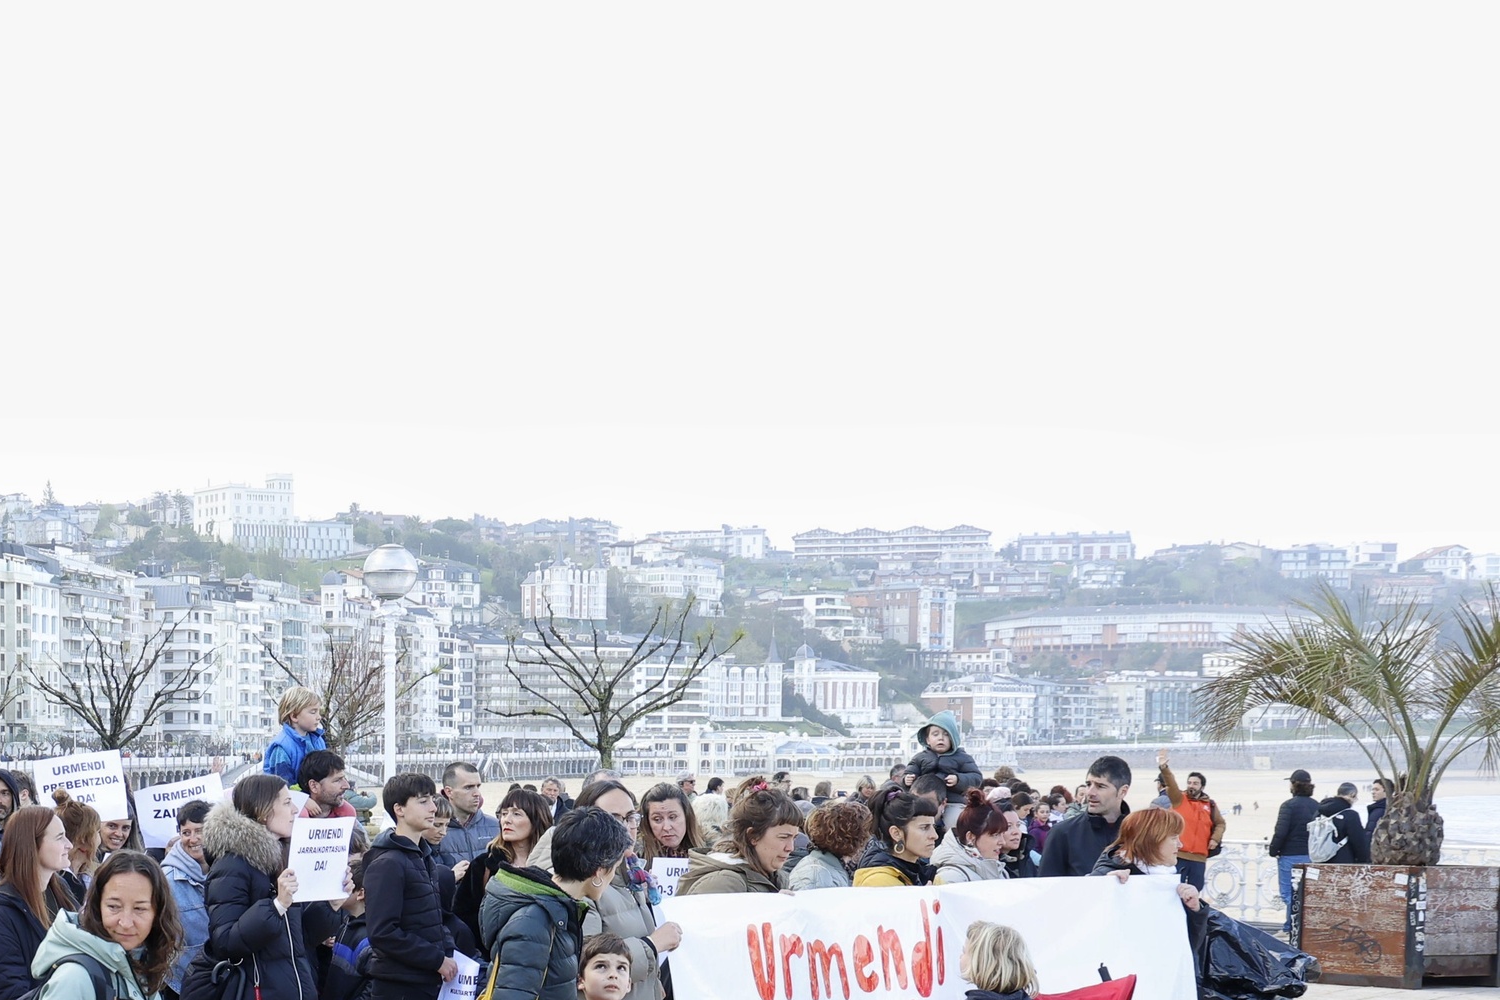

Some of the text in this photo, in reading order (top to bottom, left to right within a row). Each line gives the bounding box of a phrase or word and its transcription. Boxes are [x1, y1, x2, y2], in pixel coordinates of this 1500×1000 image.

[52, 760, 106, 776] URMENDI
[43, 774, 120, 794] PREBENTZIOA
[76, 793, 96, 804] DA!
[152, 784, 206, 802] URMENDI
[308, 828, 344, 840] URMENDI
[314, 860, 328, 871] DA!
